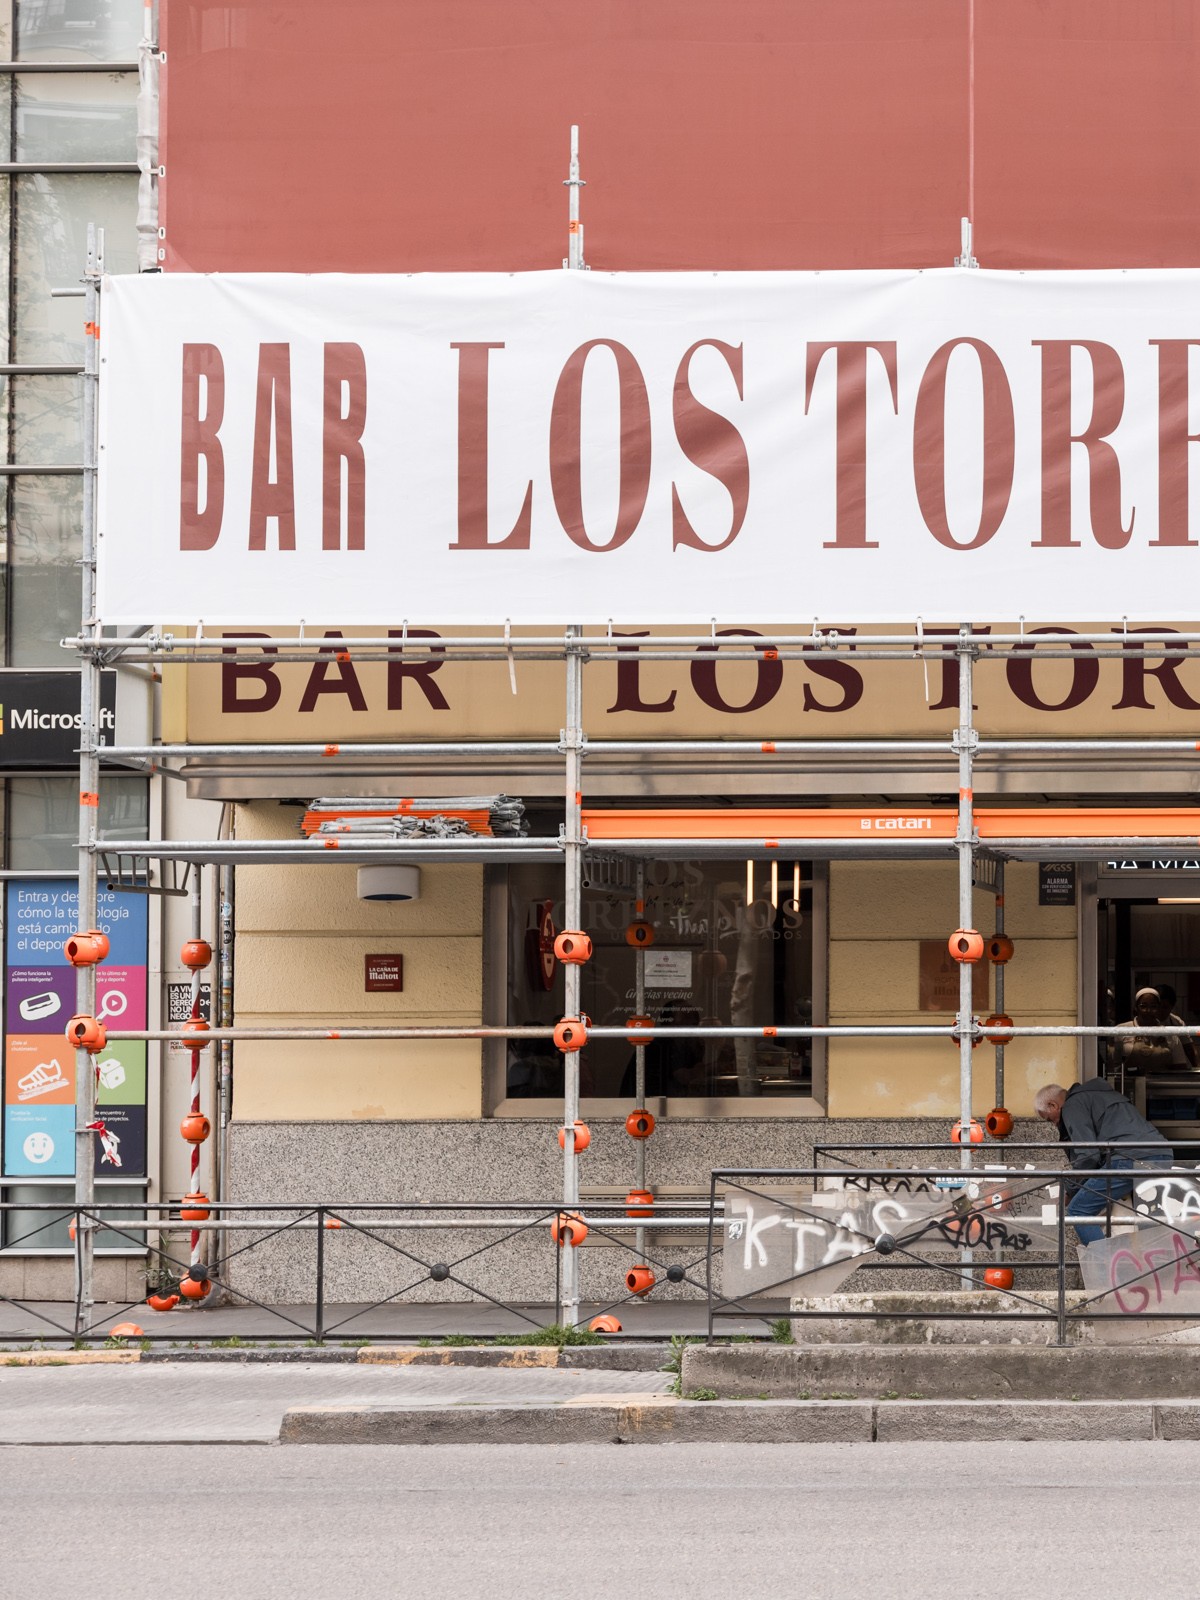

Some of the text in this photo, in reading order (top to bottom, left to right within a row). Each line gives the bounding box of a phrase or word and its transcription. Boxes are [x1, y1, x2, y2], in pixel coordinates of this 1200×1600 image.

[180, 343, 366, 550] BAR
[449, 339, 749, 552] LOS
[222, 628, 451, 713] BAR
[606, 627, 864, 713] LOS
[11, 708, 115, 729] Microsft
[875, 817, 931, 829] catari
[18, 890, 115, 905] Entra y desbre
[17, 906, 129, 921] cómo la teología
[17, 921, 110, 934] está cambdo
[17, 938, 66, 952] el depor
[369, 972, 399, 980] Mahou
[625, 988, 661, 999] Grcias
